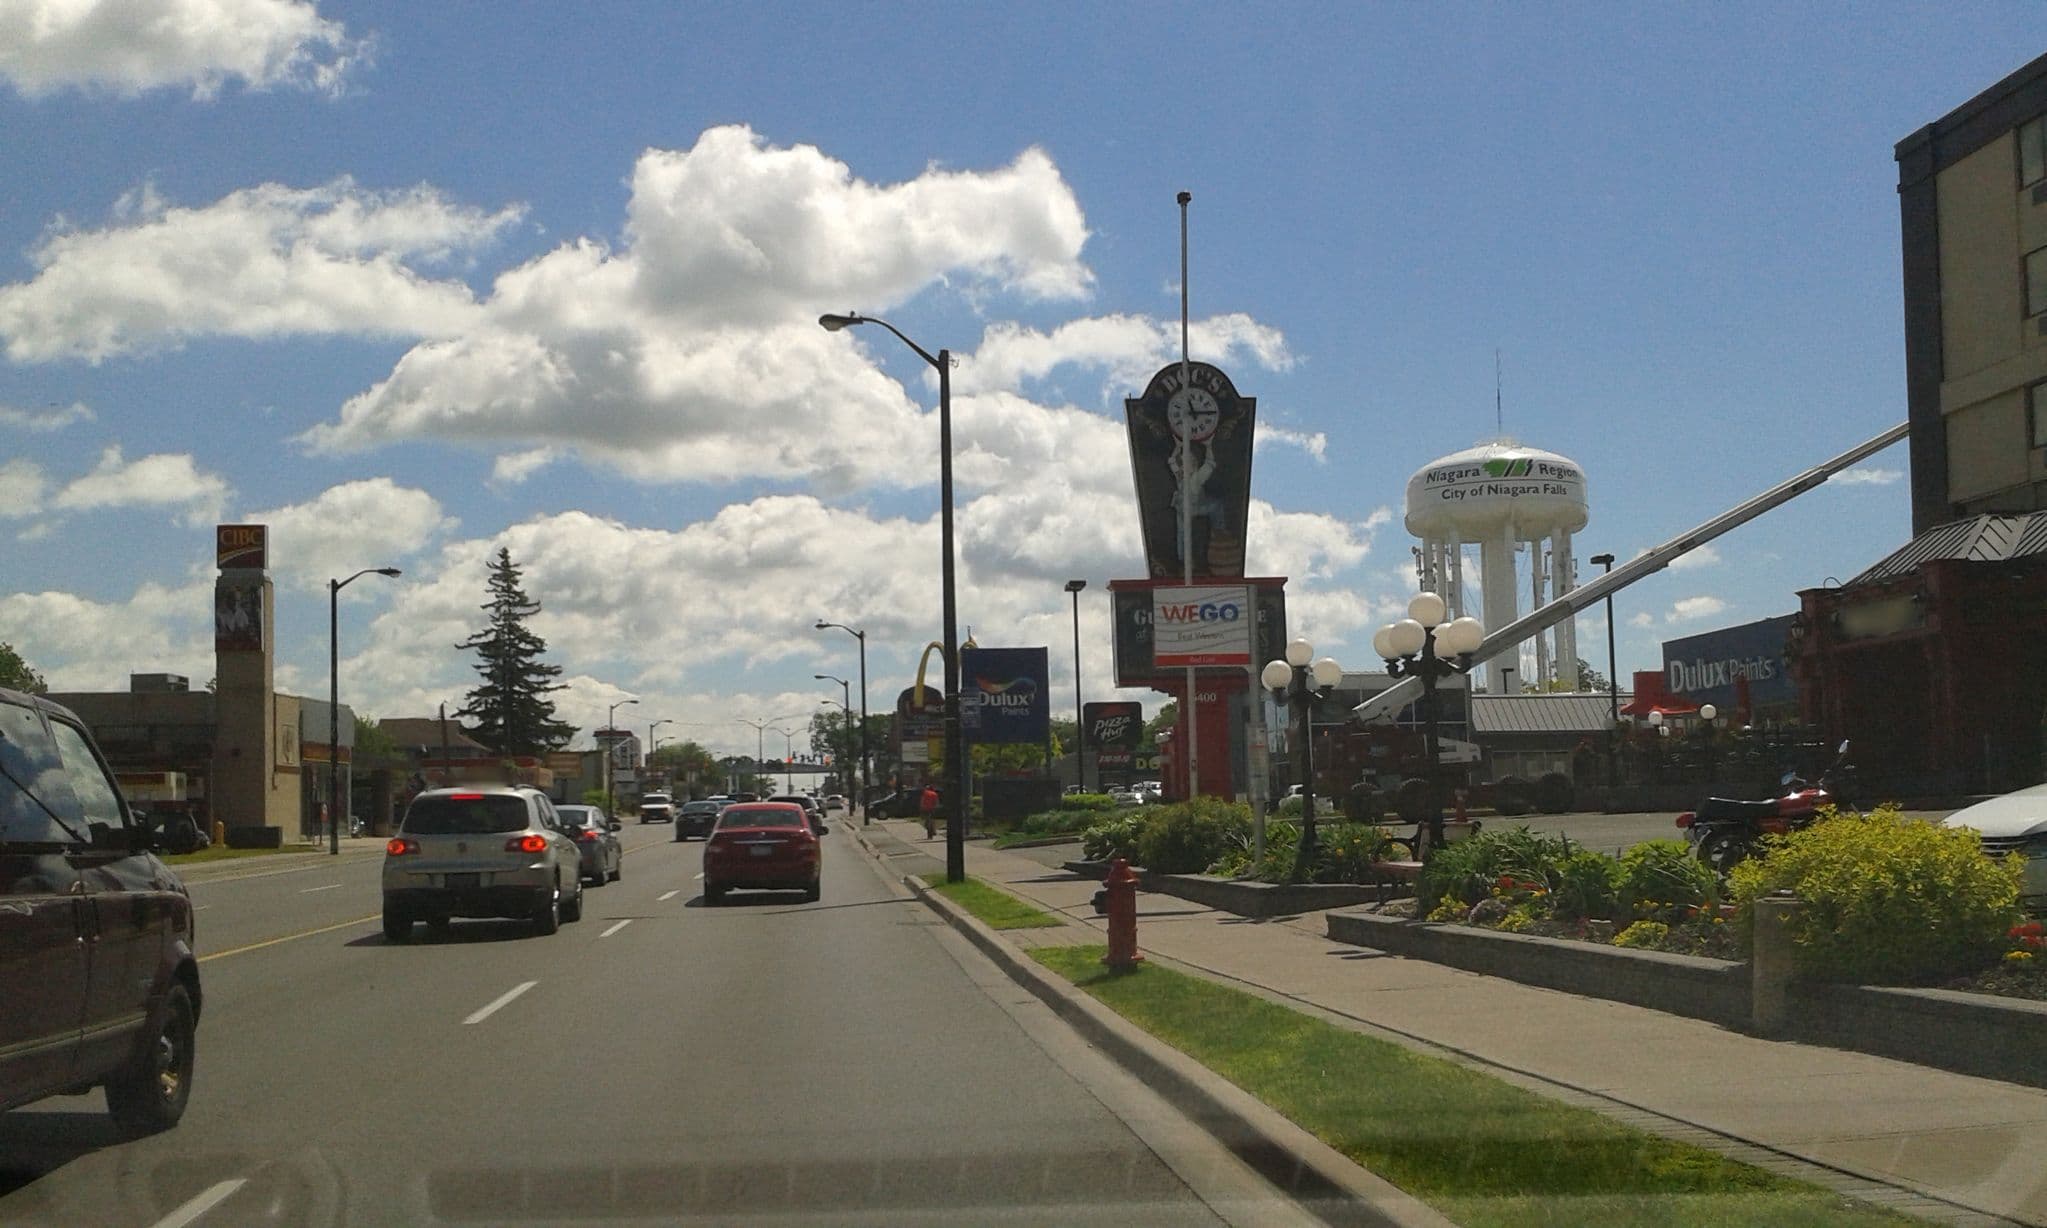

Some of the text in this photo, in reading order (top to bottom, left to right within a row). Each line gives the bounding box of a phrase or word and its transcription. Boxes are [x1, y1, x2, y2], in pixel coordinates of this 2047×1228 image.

[1160, 367, 1223, 393] DOC'S
[1426, 463, 1578, 484] Niagara Region
[1441, 483, 1567, 500] City of Niagara Falls
[220, 529, 262, 545] CIBC
[1162, 603, 1239, 622] WEGO
[1670, 656, 1774, 693] Dulux Paints
[979, 692, 1029, 707] Dulux
[1001, 706, 1030, 716] Paints
[1093, 716, 1131, 737] Pizza
[1100, 725, 1128, 741] Hut
